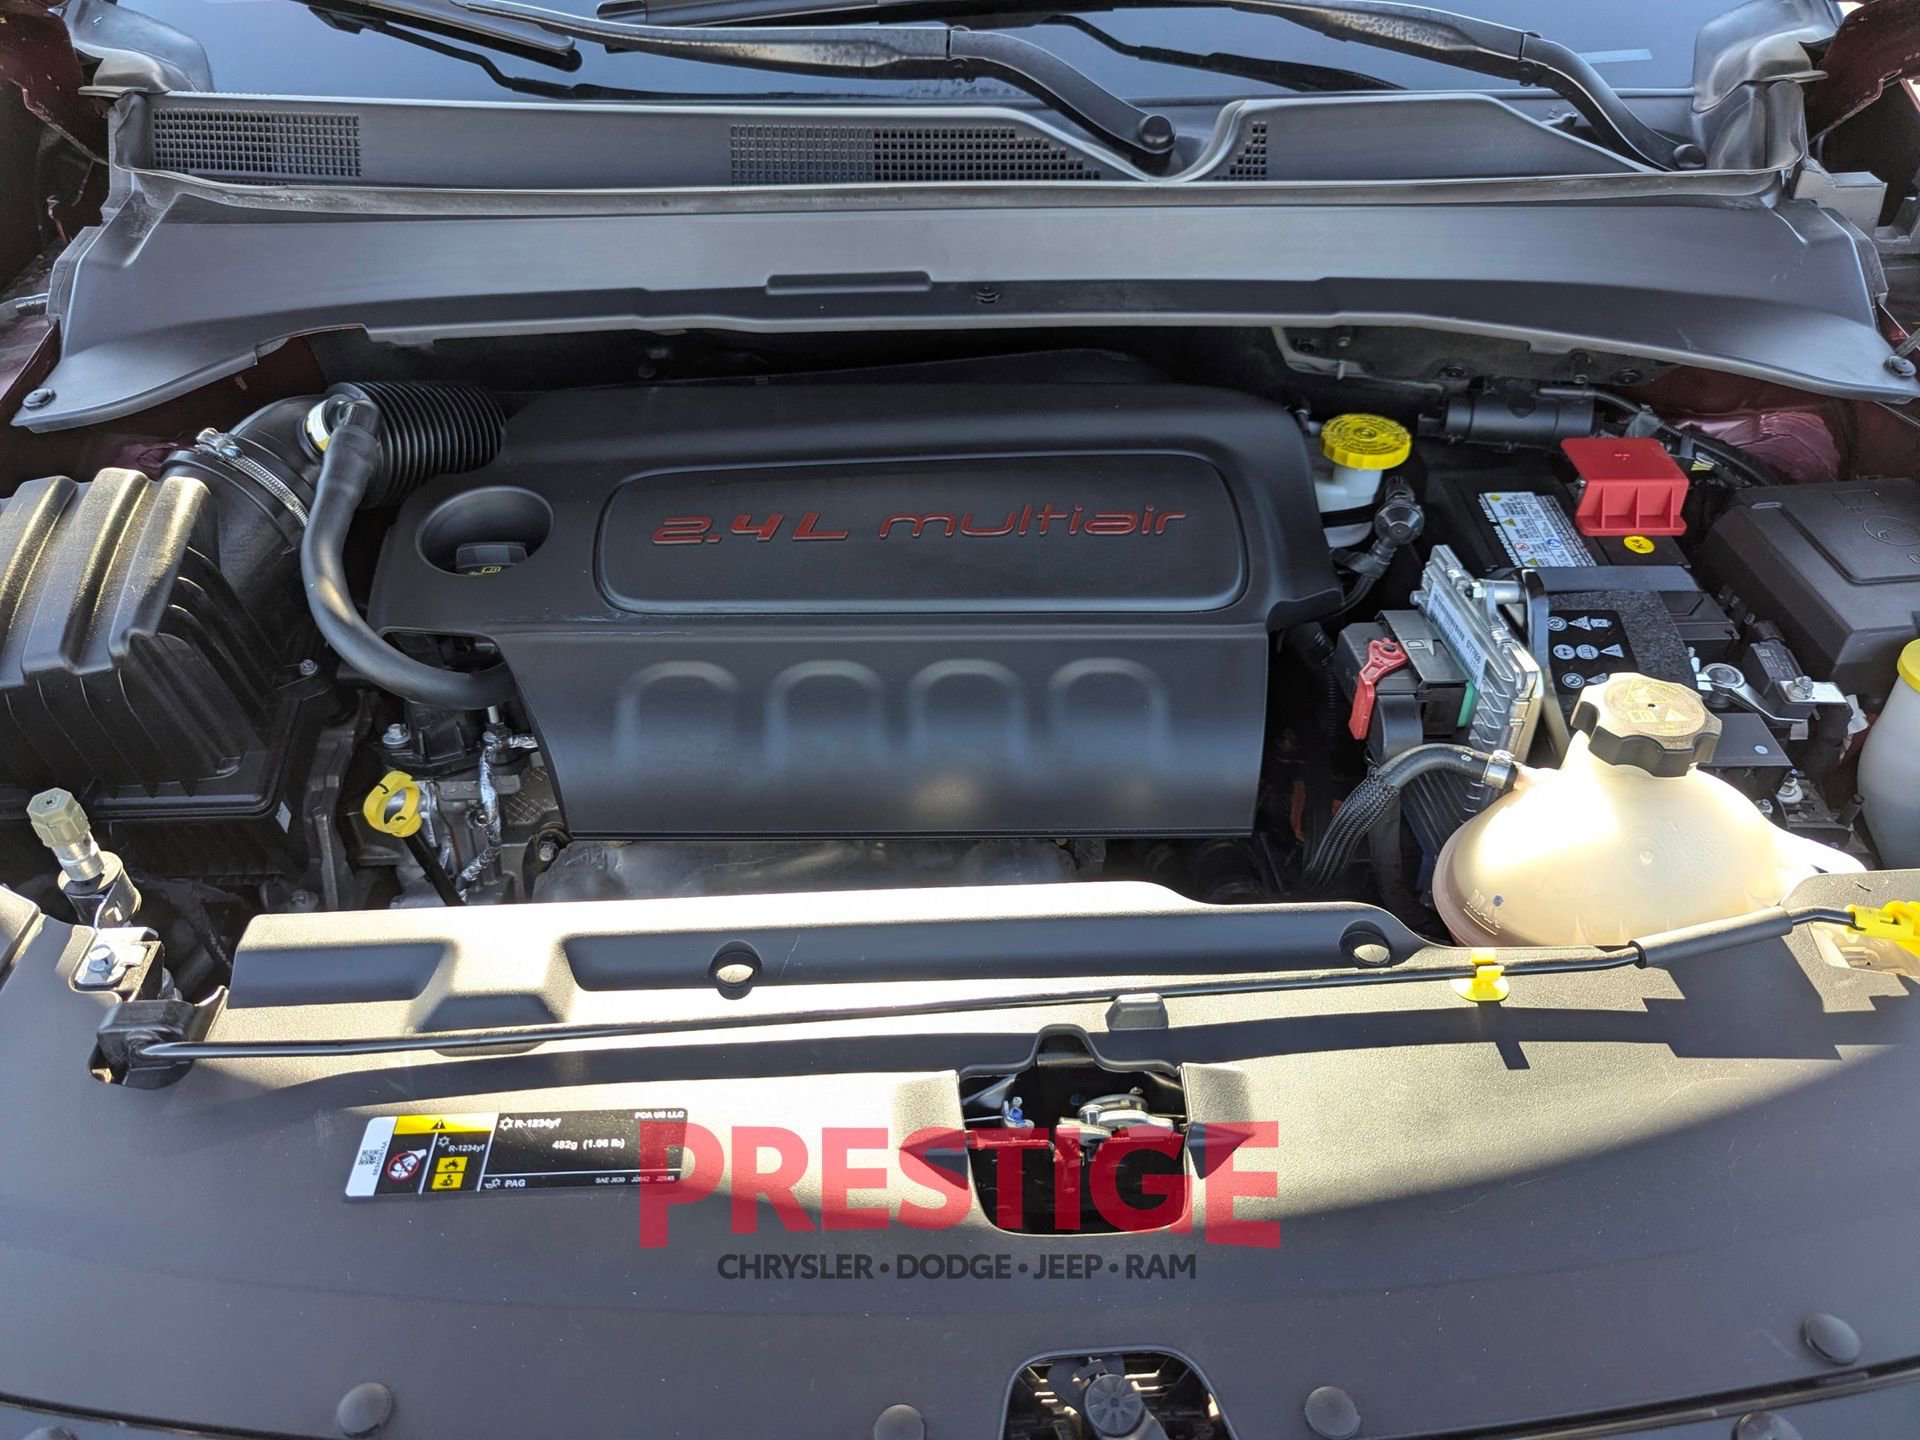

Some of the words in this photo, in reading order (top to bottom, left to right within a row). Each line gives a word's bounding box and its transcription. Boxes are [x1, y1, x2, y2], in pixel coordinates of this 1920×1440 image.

[879, 503, 1186, 538] multiair
[514, 1117, 562, 1130] R-1234yf
[448, 1144, 486, 1154] R-1234yf
[552, 1140, 578, 1151] 482g
[504, 1179, 527, 1189] PAG
